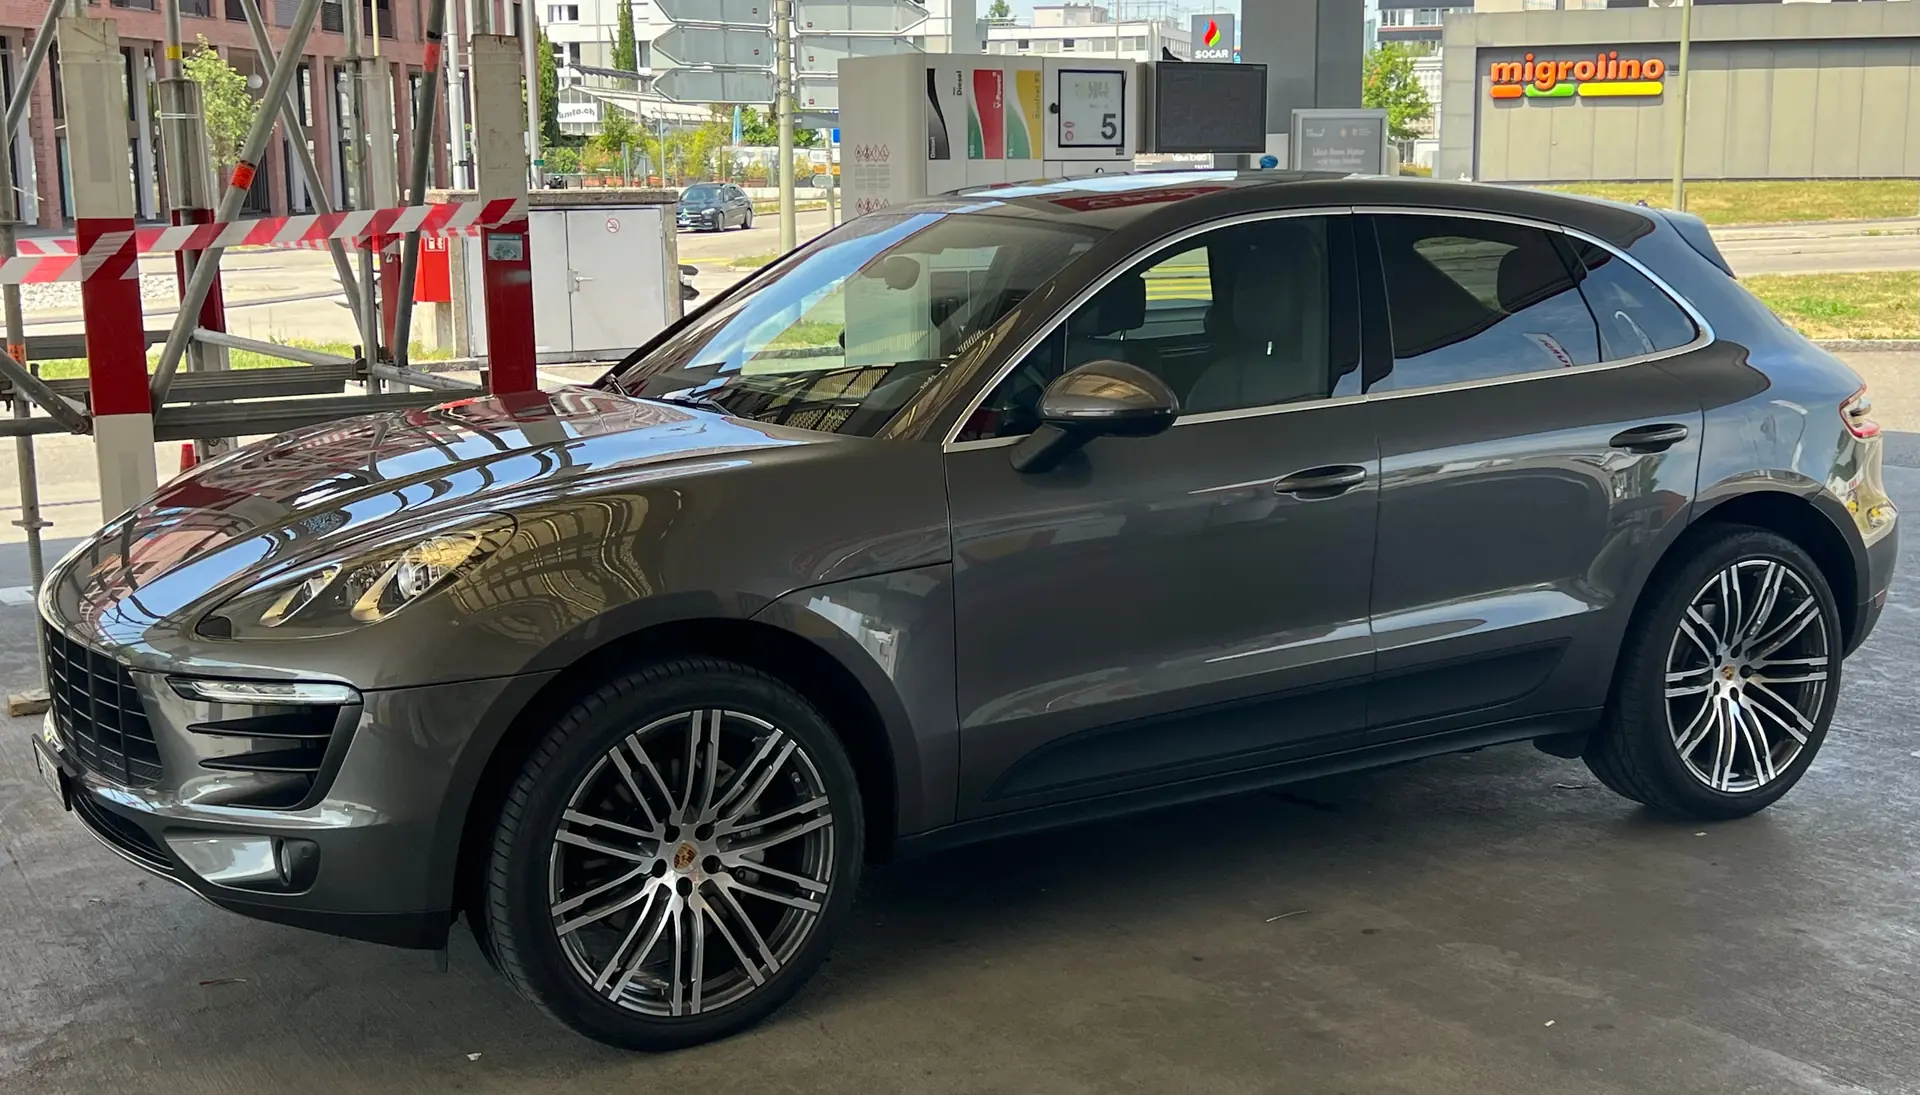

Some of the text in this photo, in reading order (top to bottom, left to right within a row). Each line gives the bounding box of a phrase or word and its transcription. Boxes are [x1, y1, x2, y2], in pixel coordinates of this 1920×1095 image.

[1194, 49, 1229, 59] SOCAR
[1490, 50, 1665, 90] migrolino
[1100, 113, 1117, 140] 5
